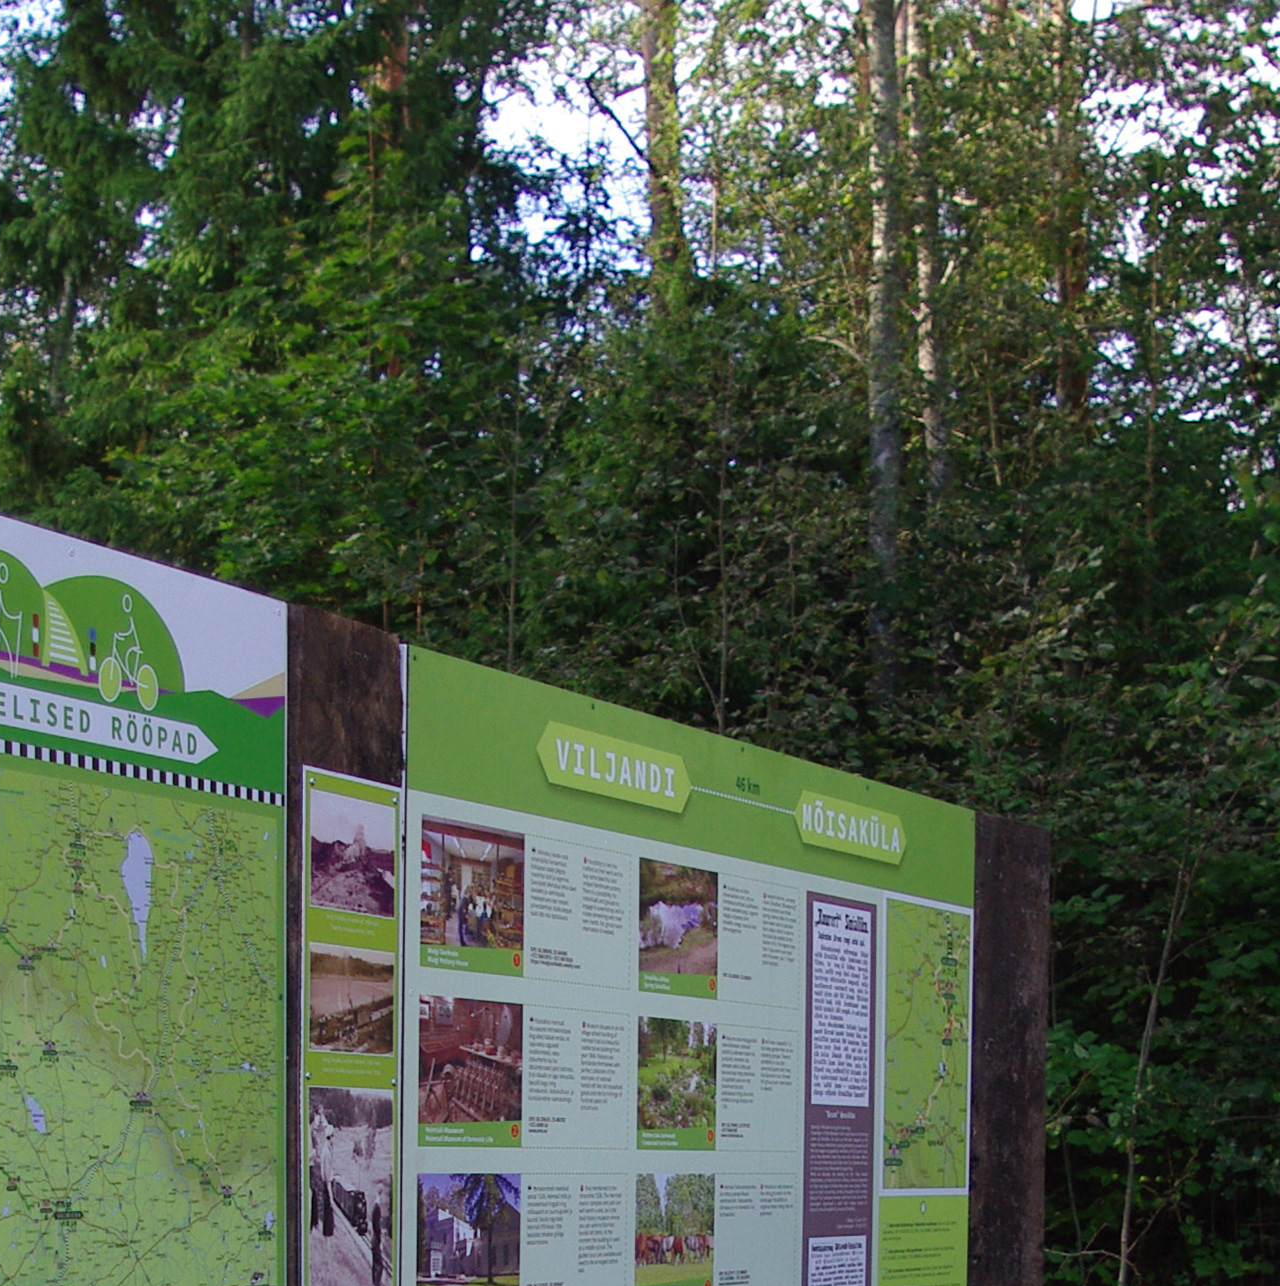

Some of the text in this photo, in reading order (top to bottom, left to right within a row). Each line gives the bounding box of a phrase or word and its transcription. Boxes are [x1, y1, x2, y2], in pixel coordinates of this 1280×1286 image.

[111, 713, 198, 756] RÖÖPAD
[555, 738, 677, 798] VILJANDI
[735, 775, 761, 796] 46 km
[801, 800, 902, 854] MÕISAKÜLA
